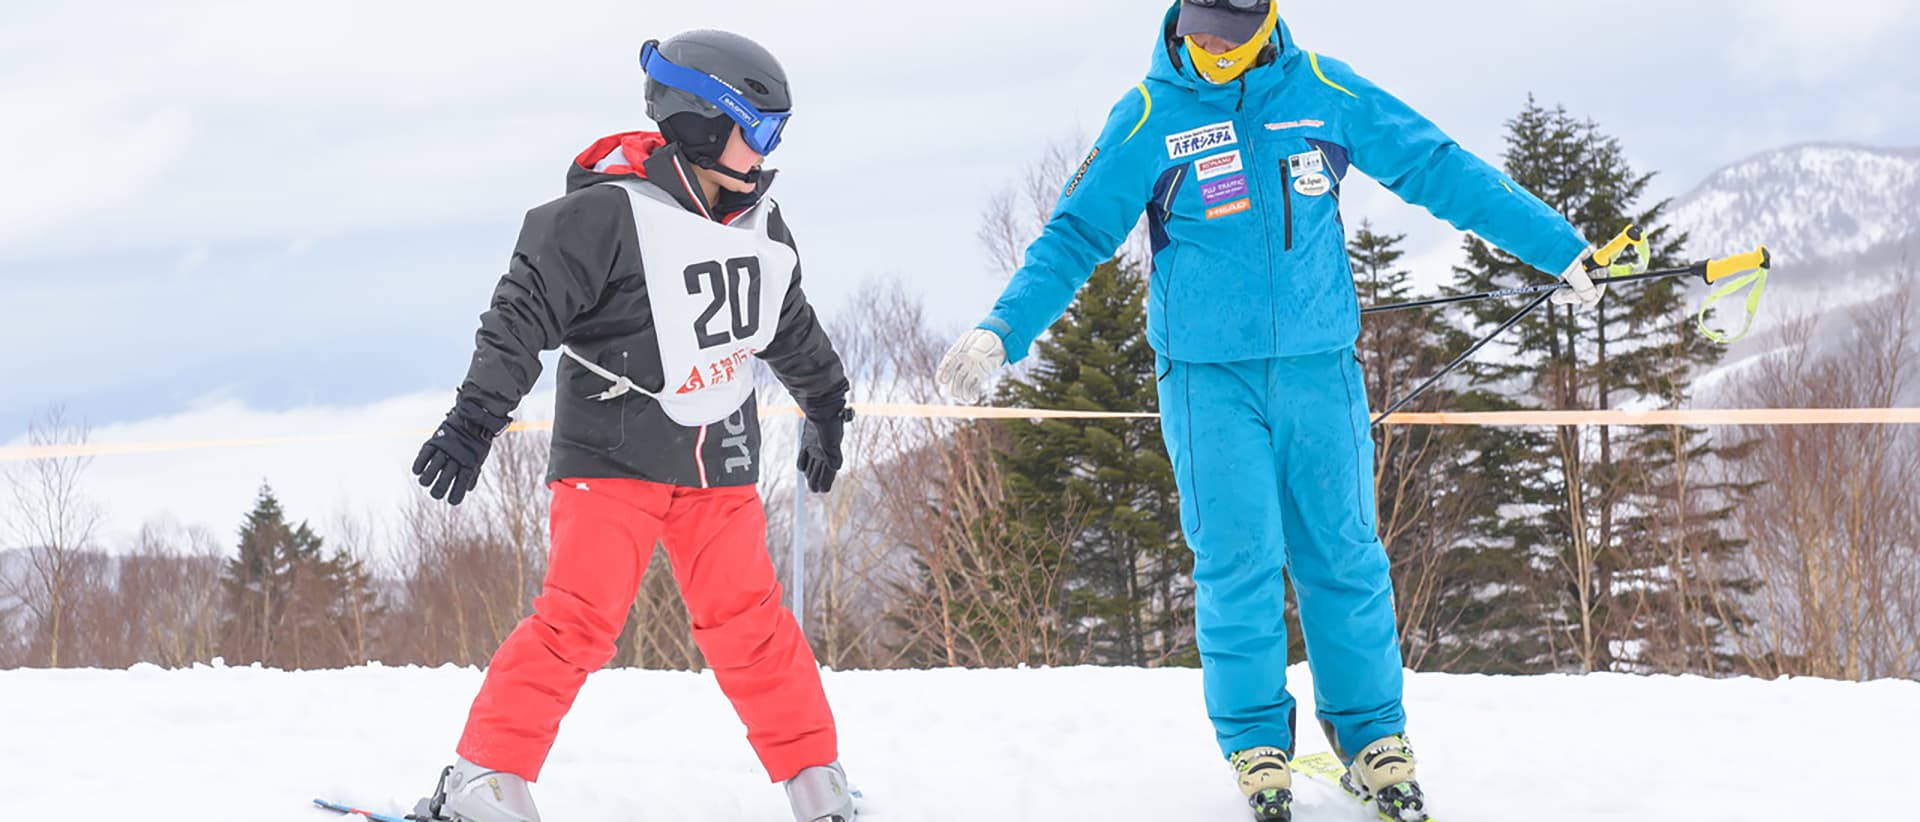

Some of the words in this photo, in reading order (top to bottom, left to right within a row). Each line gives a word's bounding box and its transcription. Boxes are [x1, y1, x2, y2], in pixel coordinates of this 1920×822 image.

[1172, 131, 1232, 156] 八千代システム
[1208, 202, 1247, 216] HEAD
[683, 255, 762, 350] 20
